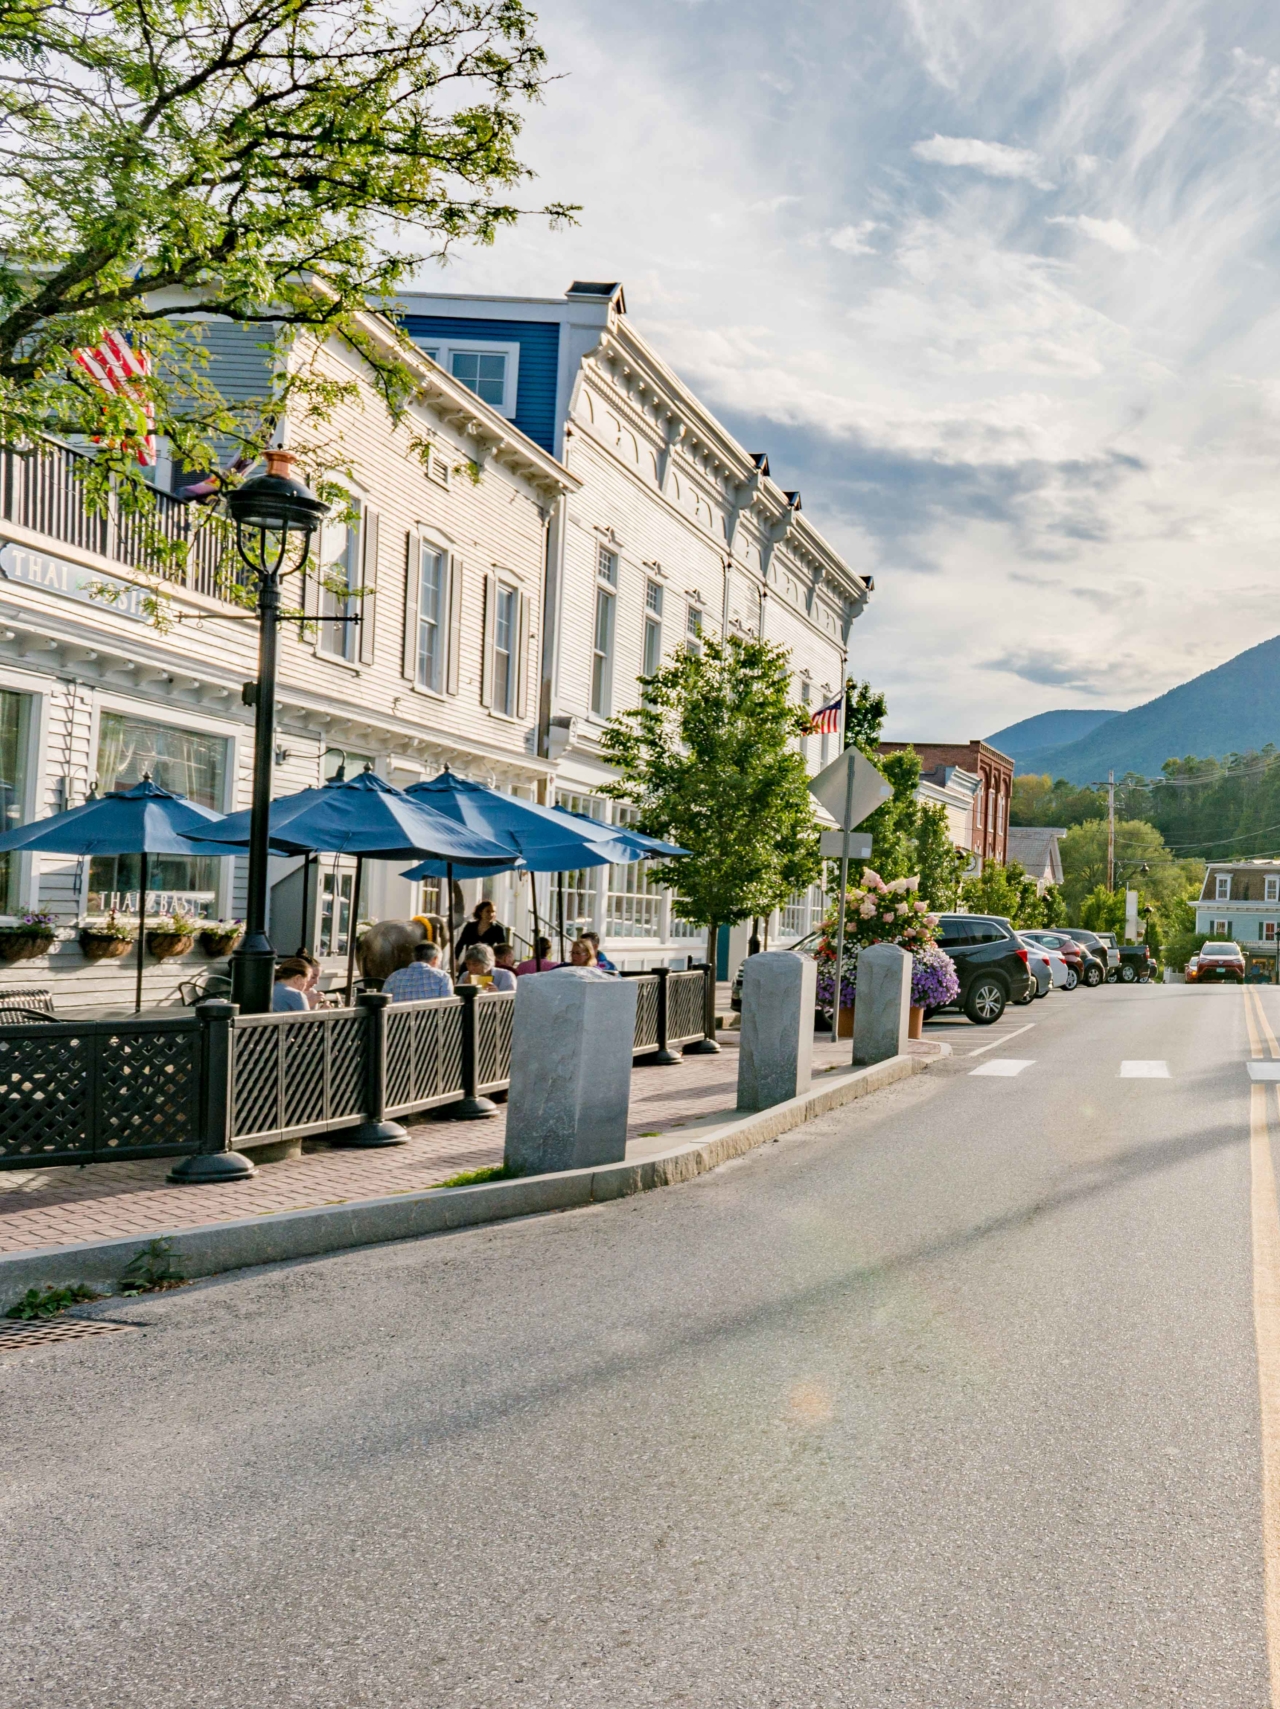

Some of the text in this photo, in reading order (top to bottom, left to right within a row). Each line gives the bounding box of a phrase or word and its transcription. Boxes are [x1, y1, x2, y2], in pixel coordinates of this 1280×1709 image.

[11, 549, 70, 591] THAI
[99, 891, 204, 914] THAI BASIL
